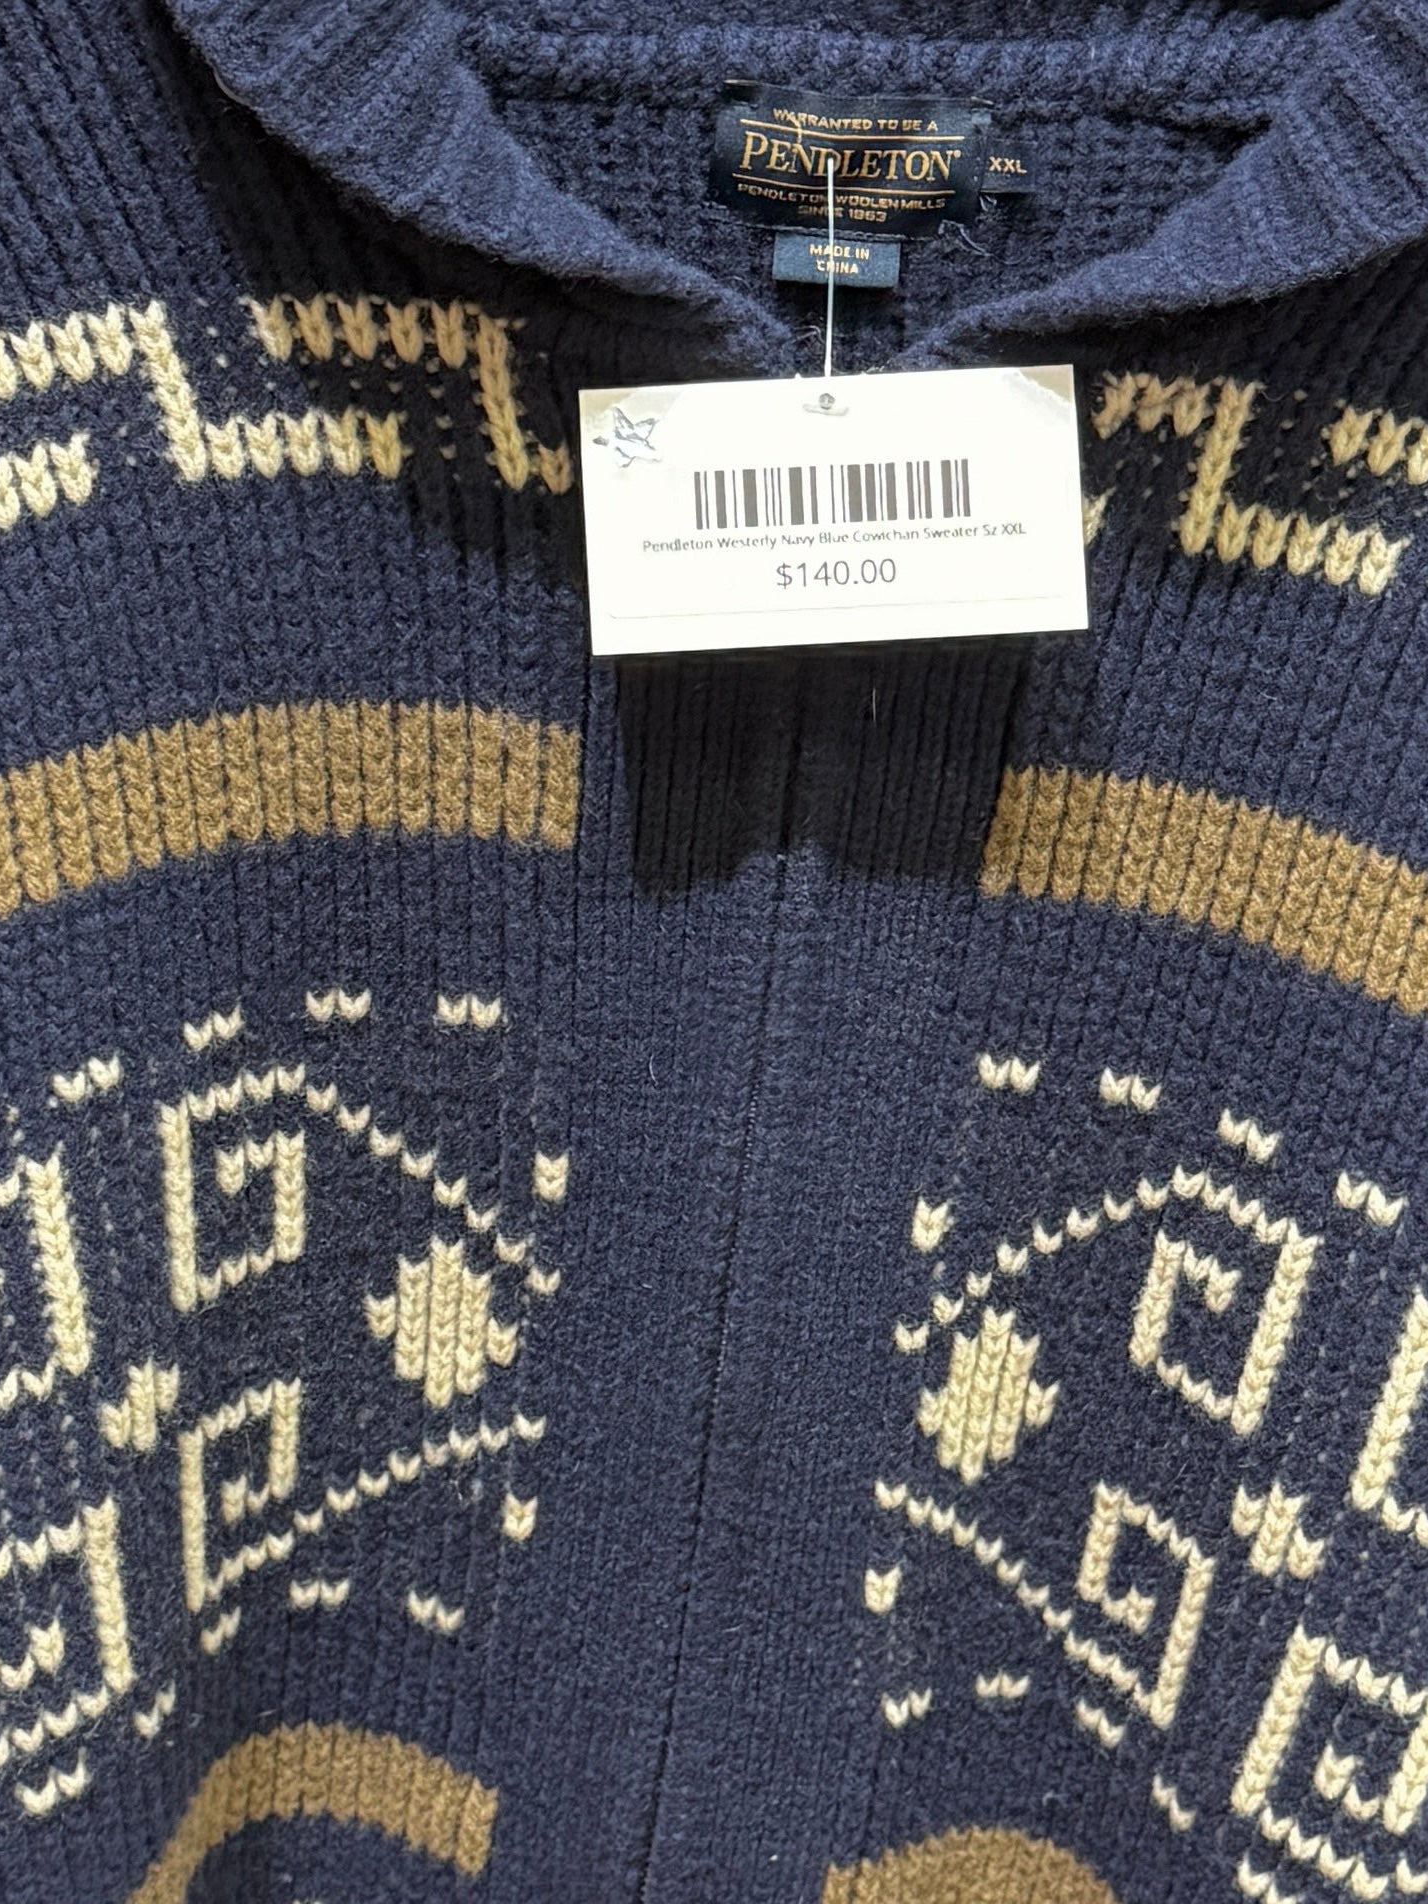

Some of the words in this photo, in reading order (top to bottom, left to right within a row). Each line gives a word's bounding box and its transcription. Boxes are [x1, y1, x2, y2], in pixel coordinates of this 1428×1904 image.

[772, 107, 873, 132] WARRANTED
[877, 118, 897, 132] TO
[902, 119, 922, 132] BE
[926, 121, 939, 133] A
[739, 130, 952, 182] PENDLETON
[988, 155, 1028, 175] XXL
[836, 194, 899, 209] WOOLEN
[900, 198, 946, 210] MILLS
[848, 208, 888, 223] 1863
[809, 243, 851, 259] MADE
[855, 247, 870, 261] IN
[815, 258, 860, 275] CHINA
[642, 538, 714, 553] Pendleton
[717, 534, 777, 550] Westerly
[781, 533, 815, 547] Navy
[819, 530, 849, 544] Blue
[852, 528, 920, 543] Cowichan
[923, 525, 979, 540] Sweater
[982, 523, 998, 537] Sz
[1001, 521, 1028, 536] XXL
[775, 557, 897, 590] $140.00
